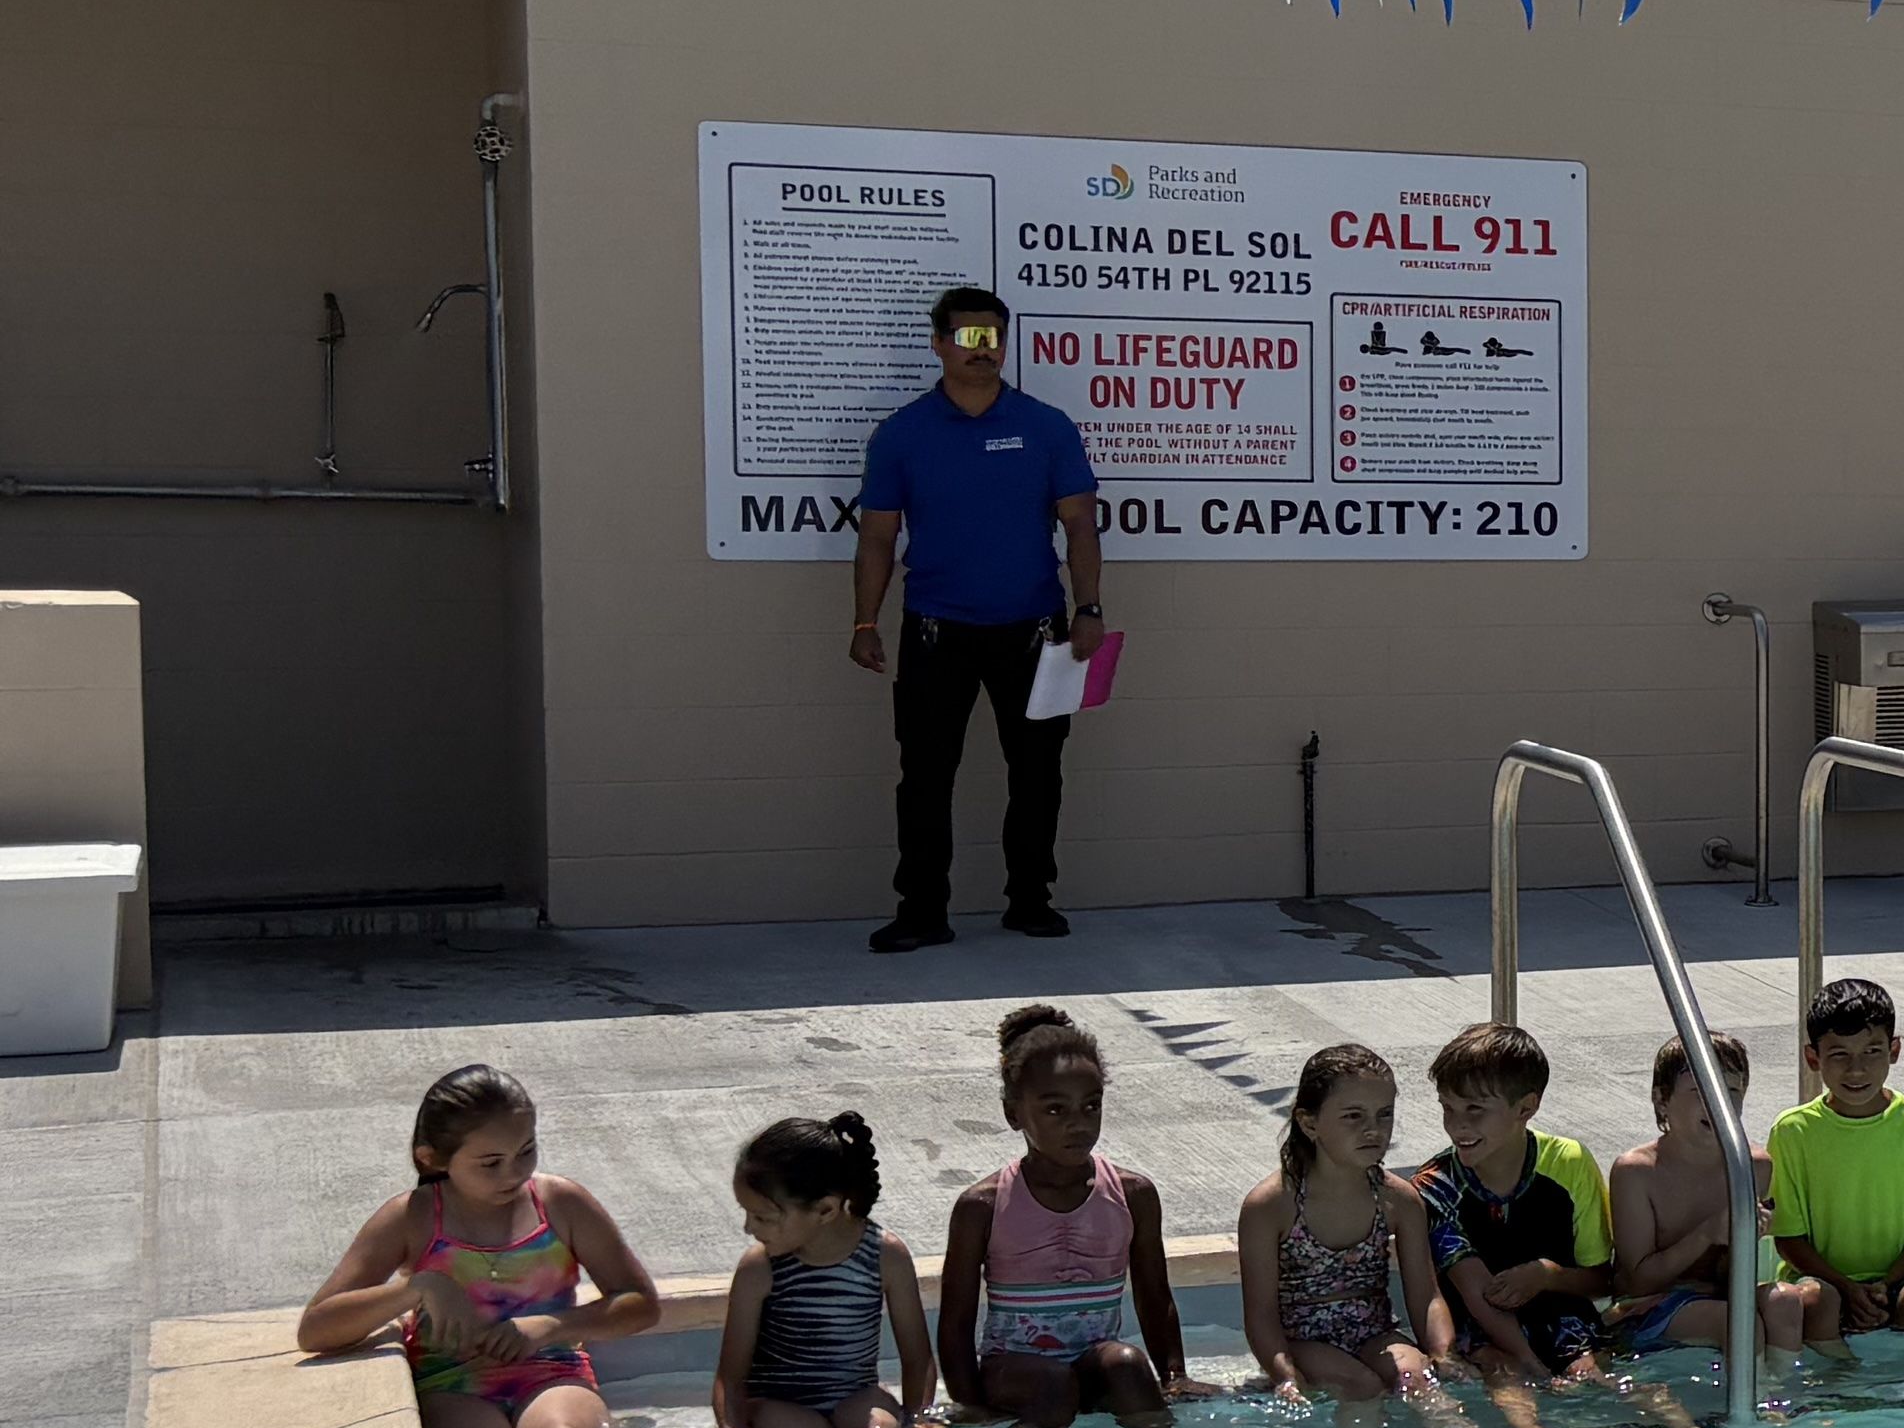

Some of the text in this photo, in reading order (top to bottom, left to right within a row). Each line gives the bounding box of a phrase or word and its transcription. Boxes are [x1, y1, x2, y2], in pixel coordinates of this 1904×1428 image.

[1149, 165, 1237, 185] Parks and
[781, 183, 946, 207] POOL RULES
[1149, 183, 1245, 203] Recreation
[1400, 191, 1491, 209] EMERGENCY
[1019, 222, 1312, 259] COLINA DEL SOL
[1330, 210, 1558, 255] CALL 911
[1017, 263, 1312, 295] 4150 54TH PL 92115
[1342, 302, 1550, 321] CPR/ARTIFICIAL RESPIRATION
[1033, 331, 1298, 370] NO LIFEGUARD
[1089, 375, 1245, 410] ON DUTY
[1107, 422, 1152, 433] UNDER
[1157, 423, 1183, 433] THE
[1186, 424, 1211, 434] AGE
[1216, 424, 1232, 434] OF
[1237, 424, 1251, 435] 14
[1256, 425, 1298, 435] SHALL
[1097, 437, 1122, 448] THE
[1128, 438, 1162, 448] POOL
[1168, 439, 1229, 449] WITHOUT
[1233, 439, 1242, 449] A
[1246, 439, 1297, 450] PARENT
[1112, 452, 1180, 464] GUARDIAN
[1185, 454, 1199, 464] IN
[1201, 454, 1287, 465] ATTENDANCE
[1201, 499, 1461, 535] CAPACITY:
[1476, 501, 1558, 536] 210
